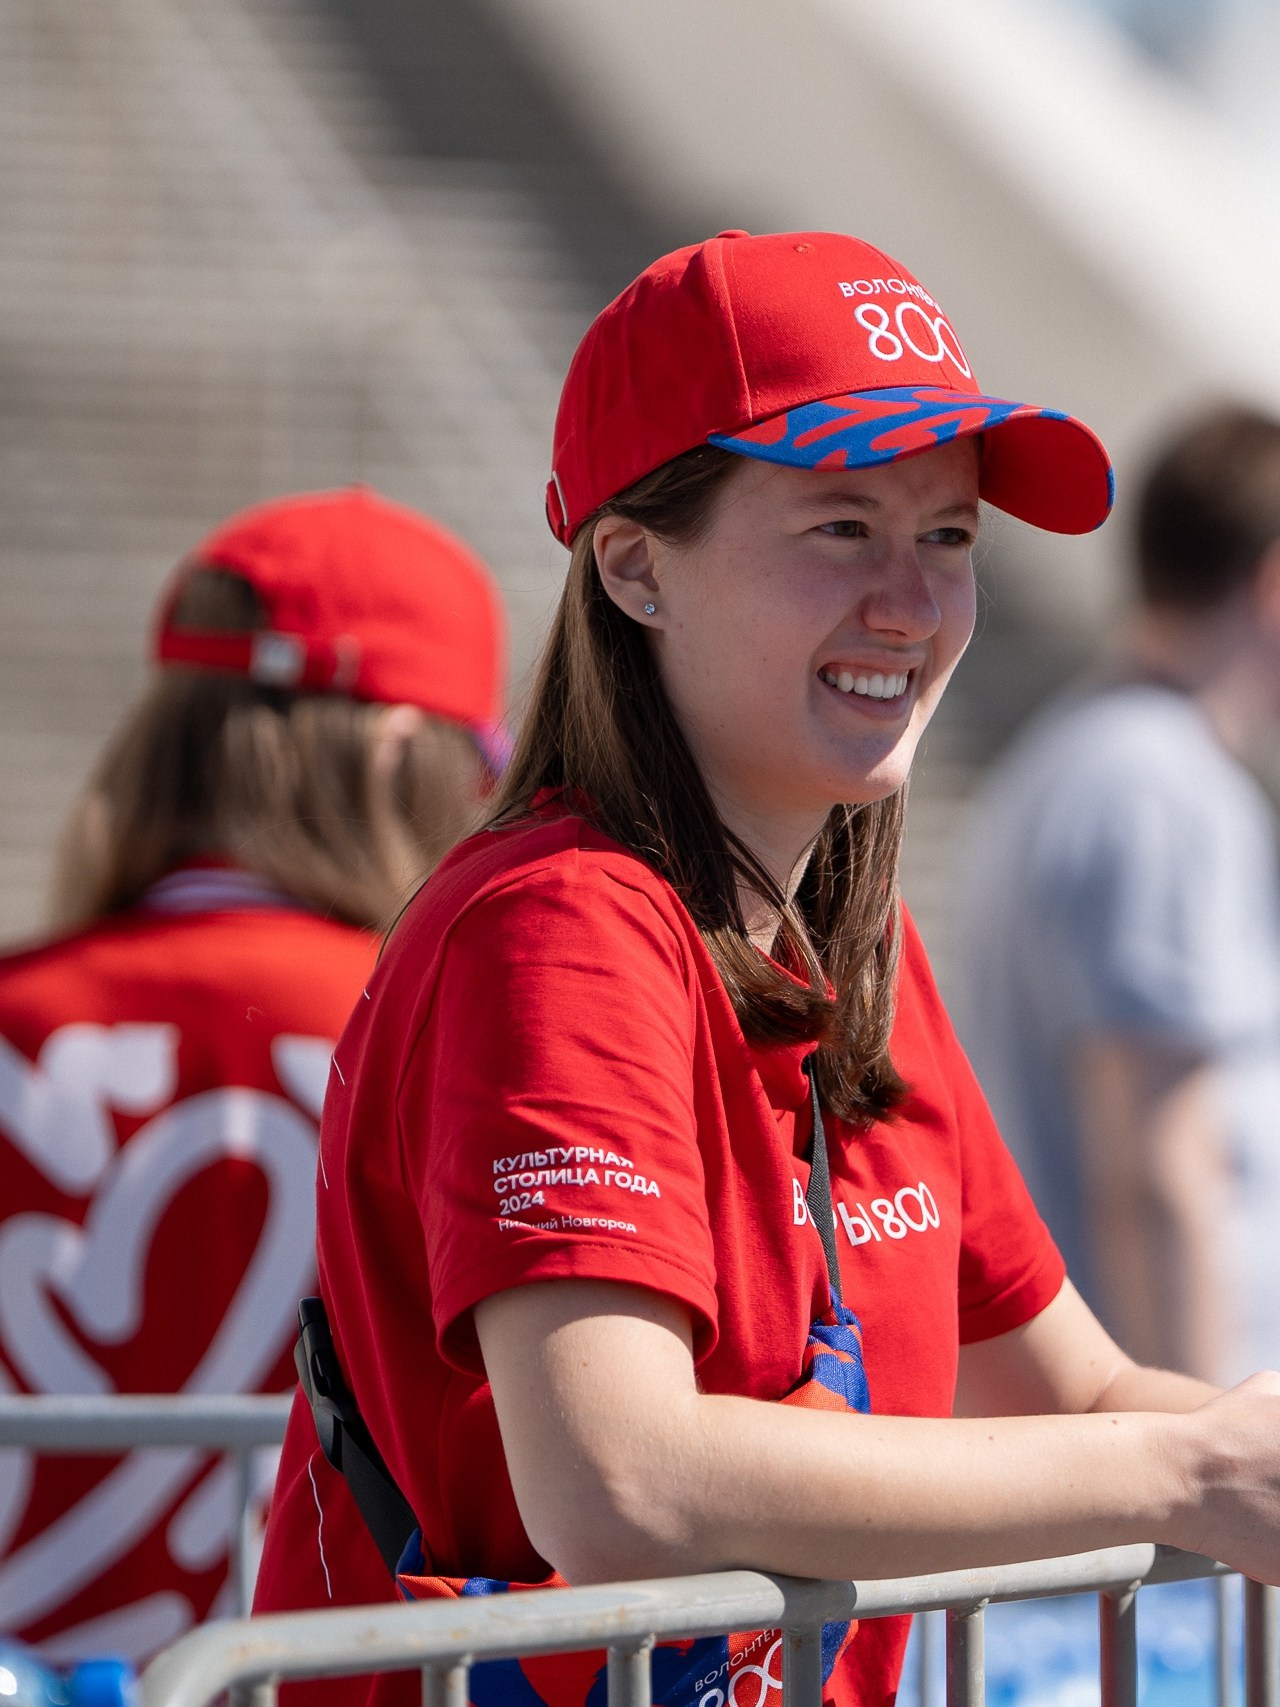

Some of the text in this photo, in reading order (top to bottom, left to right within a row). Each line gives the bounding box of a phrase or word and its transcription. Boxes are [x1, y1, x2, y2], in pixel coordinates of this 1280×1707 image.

[854, 302, 972, 379] 800
[493, 1146, 634, 1174] КУЛЬТУРНАЯ
[493, 1167, 661, 1198] СТОЛИЦА ГОДА
[499, 1190, 546, 1216] 2024
[561, 1215, 637, 1233] Новгород
